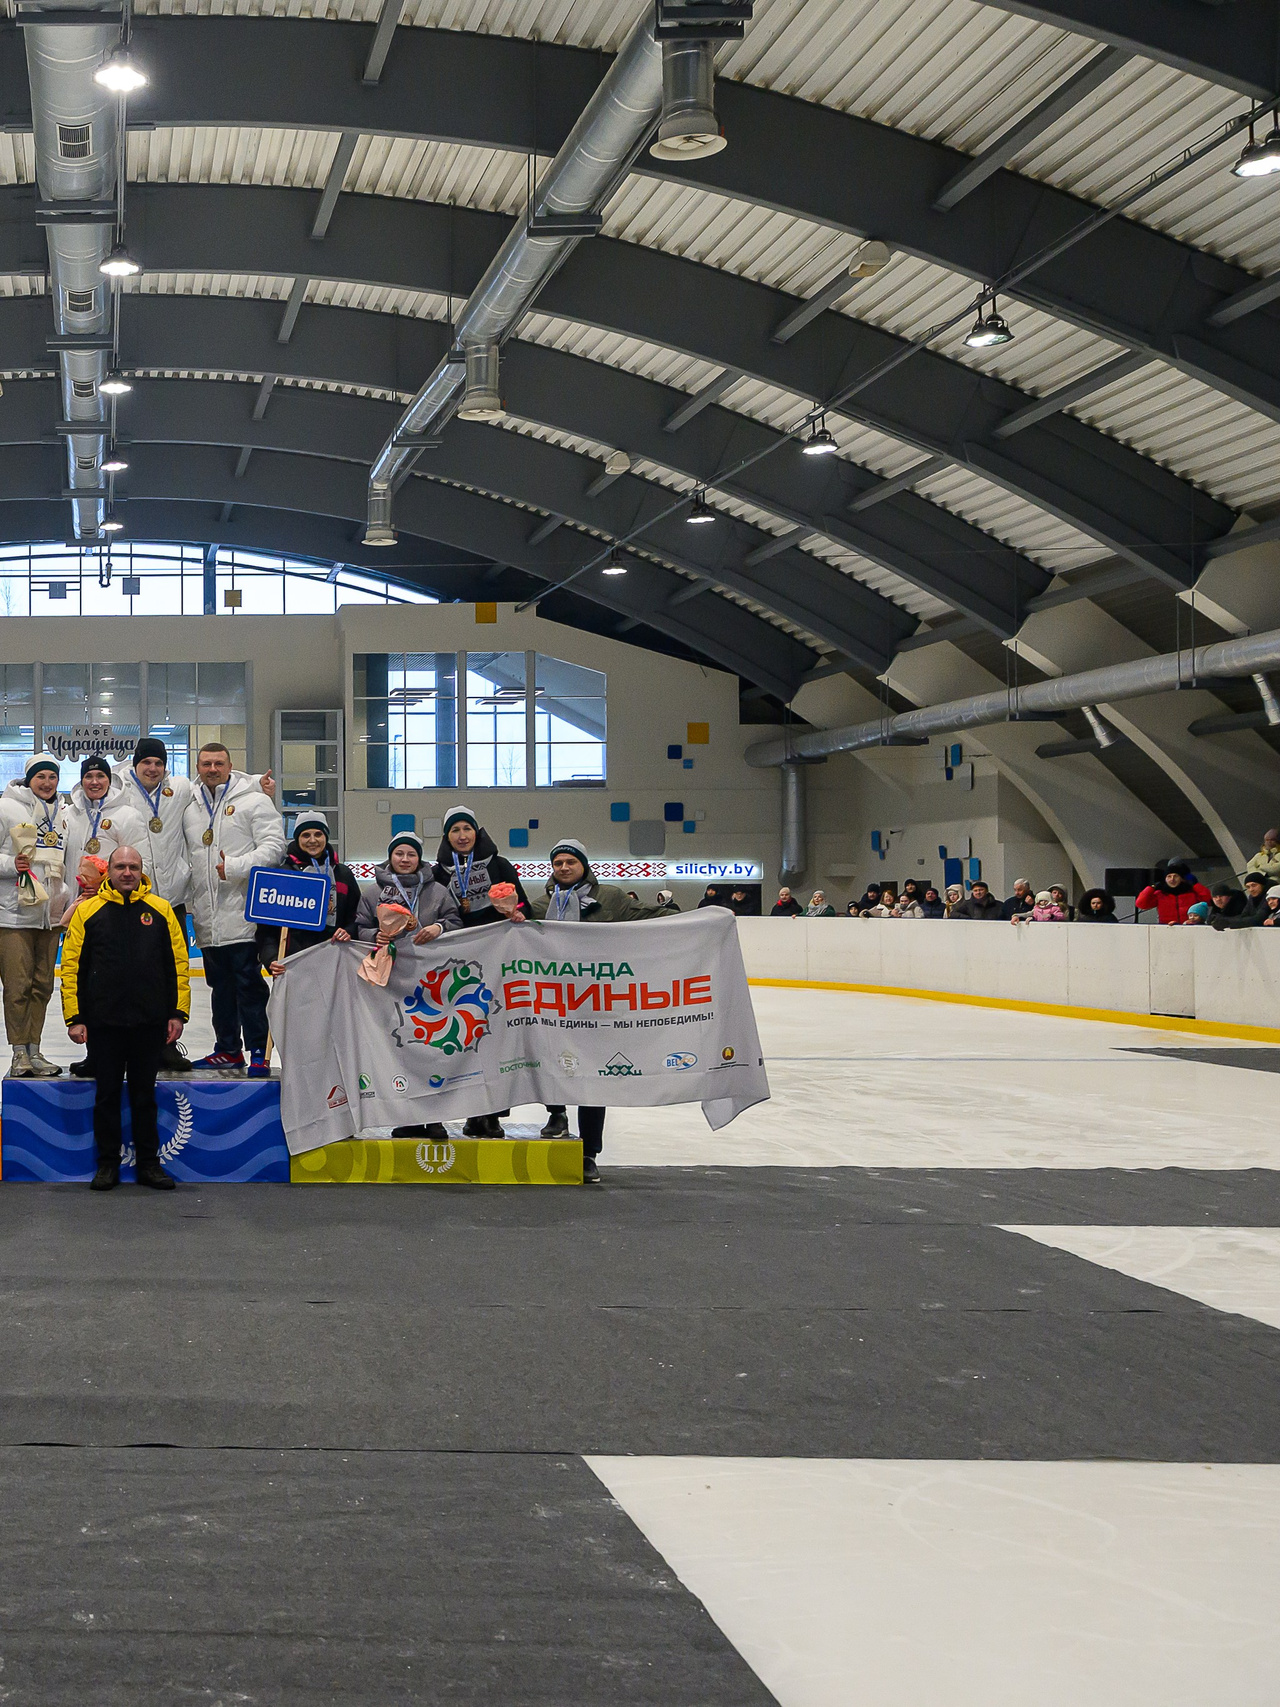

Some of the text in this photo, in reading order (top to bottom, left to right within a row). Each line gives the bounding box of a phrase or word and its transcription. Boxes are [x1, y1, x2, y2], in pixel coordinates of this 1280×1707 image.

[48, 735, 136, 758] Чараўніца
[676, 863, 754, 876] silichy.by
[454, 873, 486, 889] ЕНЫЕ
[259, 887, 316, 910] Единые
[501, 959, 634, 980] КОМАНДА
[503, 975, 712, 1017] ЕДИНЫЕ
[507, 1017, 538, 1028] КОГДА
[541, 1018, 557, 1027] МЫ
[559, 1020, 598, 1029] ЕДИНЫ
[613, 1021, 633, 1029] МЫ
[636, 1012, 714, 1028] НЕПОБЕДИМЫ!
[422, 1144, 449, 1162] III
